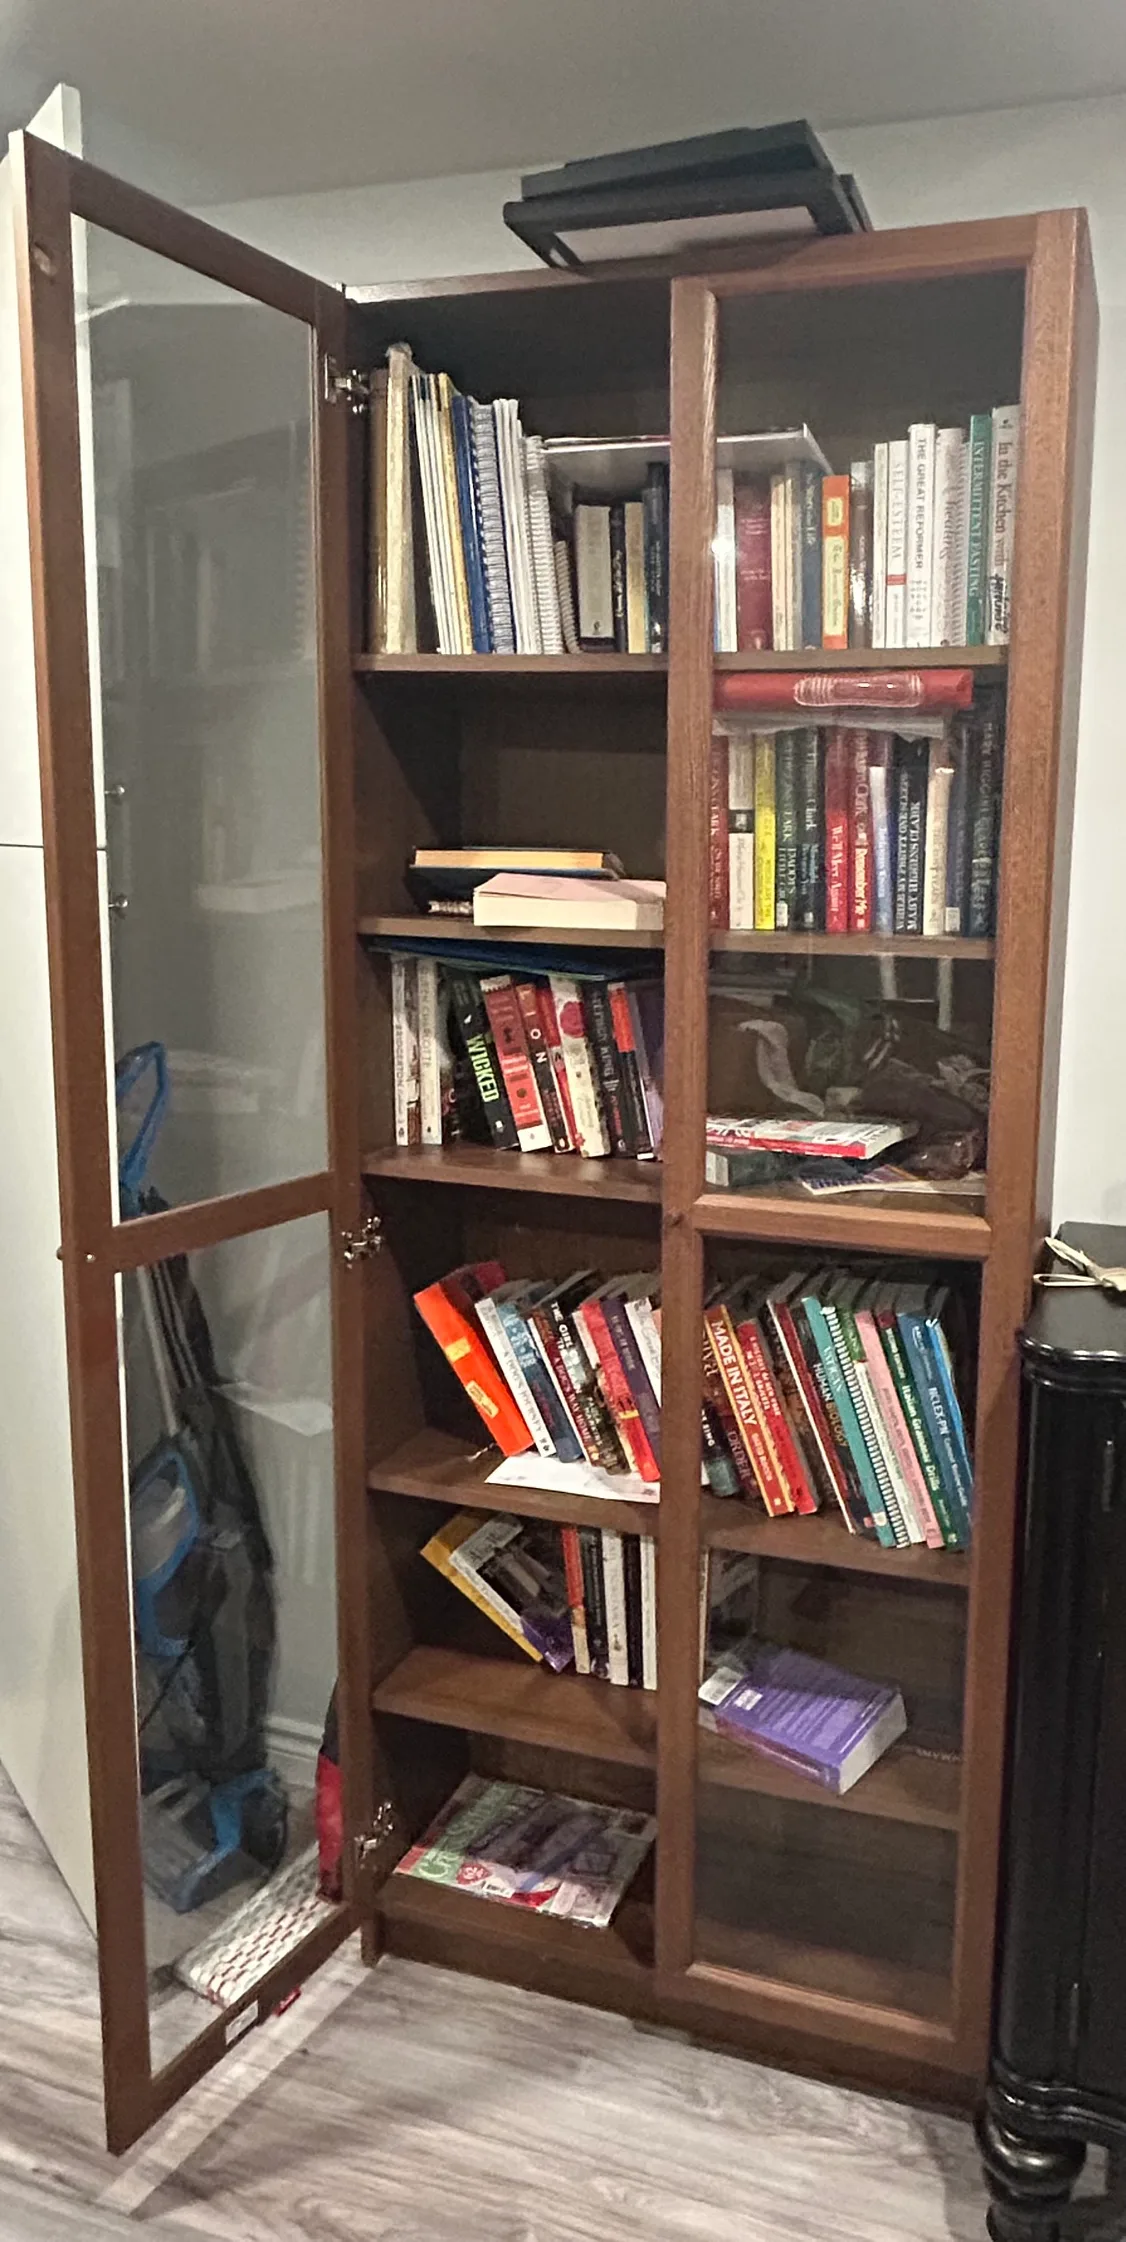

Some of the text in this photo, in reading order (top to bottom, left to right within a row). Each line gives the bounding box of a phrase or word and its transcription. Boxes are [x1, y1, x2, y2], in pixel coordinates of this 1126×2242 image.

[916, 438, 926, 460] THE
[996, 459, 1010, 479] the
[997, 442, 1010, 456] In
[915, 464, 926, 500] GREAT
[890, 462, 903, 559] SELF-ESTEEM
[969, 441, 983, 597] INTERMITTENT FASTING
[994, 483, 1011, 532] Kitchen
[915, 505, 925, 569] REFORMER
[805, 798, 817, 830] Clark
[831, 825, 842, 849] We'll
[899, 810, 907, 832] ONE
[830, 852, 842, 876] Meet
[898, 835, 908, 872] PRETTY
[906, 800, 921, 929] MARY HIGGINS CLARK
[854, 848, 868, 914] Remember Me
[898, 877, 906, 890] MY
[419, 1006, 432, 1067] CHARLOTTE
[518, 988, 547, 1064] LION
[395, 1024, 403, 1086] BRIDGERTON
[464, 1034, 500, 1104] WICKED
[599, 1045, 614, 1077] KING
[549, 1301, 563, 1322] THE
[557, 1322, 574, 1347] GIRL
[710, 1319, 758, 1427] MADE IN ITALY
[764, 1381, 775, 1397] NEW
[519, 1390, 542, 1432] JOURNEY
[551, 1355, 592, 1442] A DOG'S WAY HOME
[812, 1361, 847, 1448] HUMAN BIOLOGY
[726, 1429, 752, 1479] ORDER
[900, 1383, 919, 1417] Italian
[910, 1417, 933, 1463] Grammar
[924, 1463, 941, 1491] Drills
[927, 1386, 949, 1435] NCLEX-PN
[956, 1486, 968, 1507] Guide
